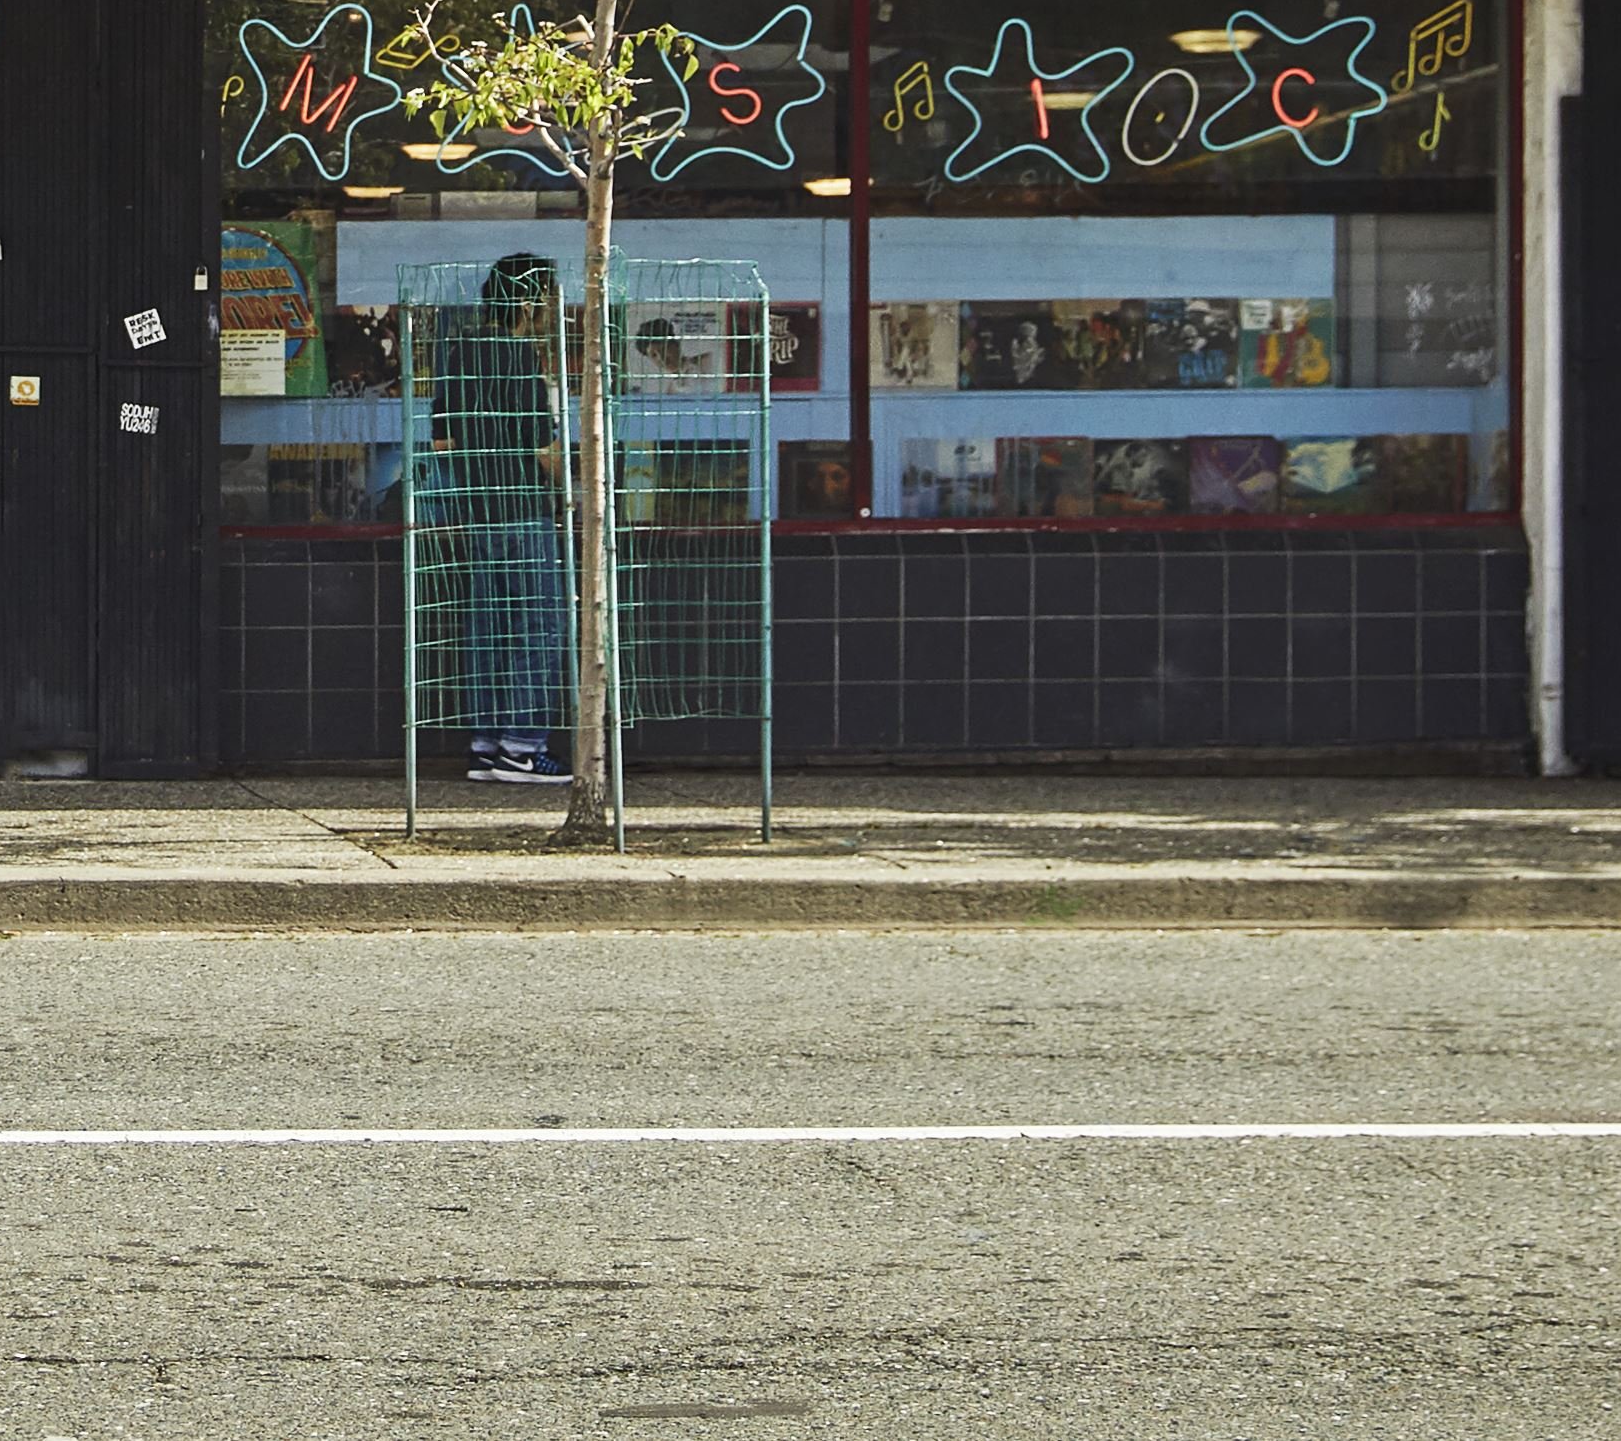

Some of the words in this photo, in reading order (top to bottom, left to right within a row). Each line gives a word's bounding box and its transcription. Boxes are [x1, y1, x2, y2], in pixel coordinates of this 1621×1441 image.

[221, 269, 248, 290] ORE
[221, 293, 317, 336] ORE!
[769, 334, 800, 364] RIP
